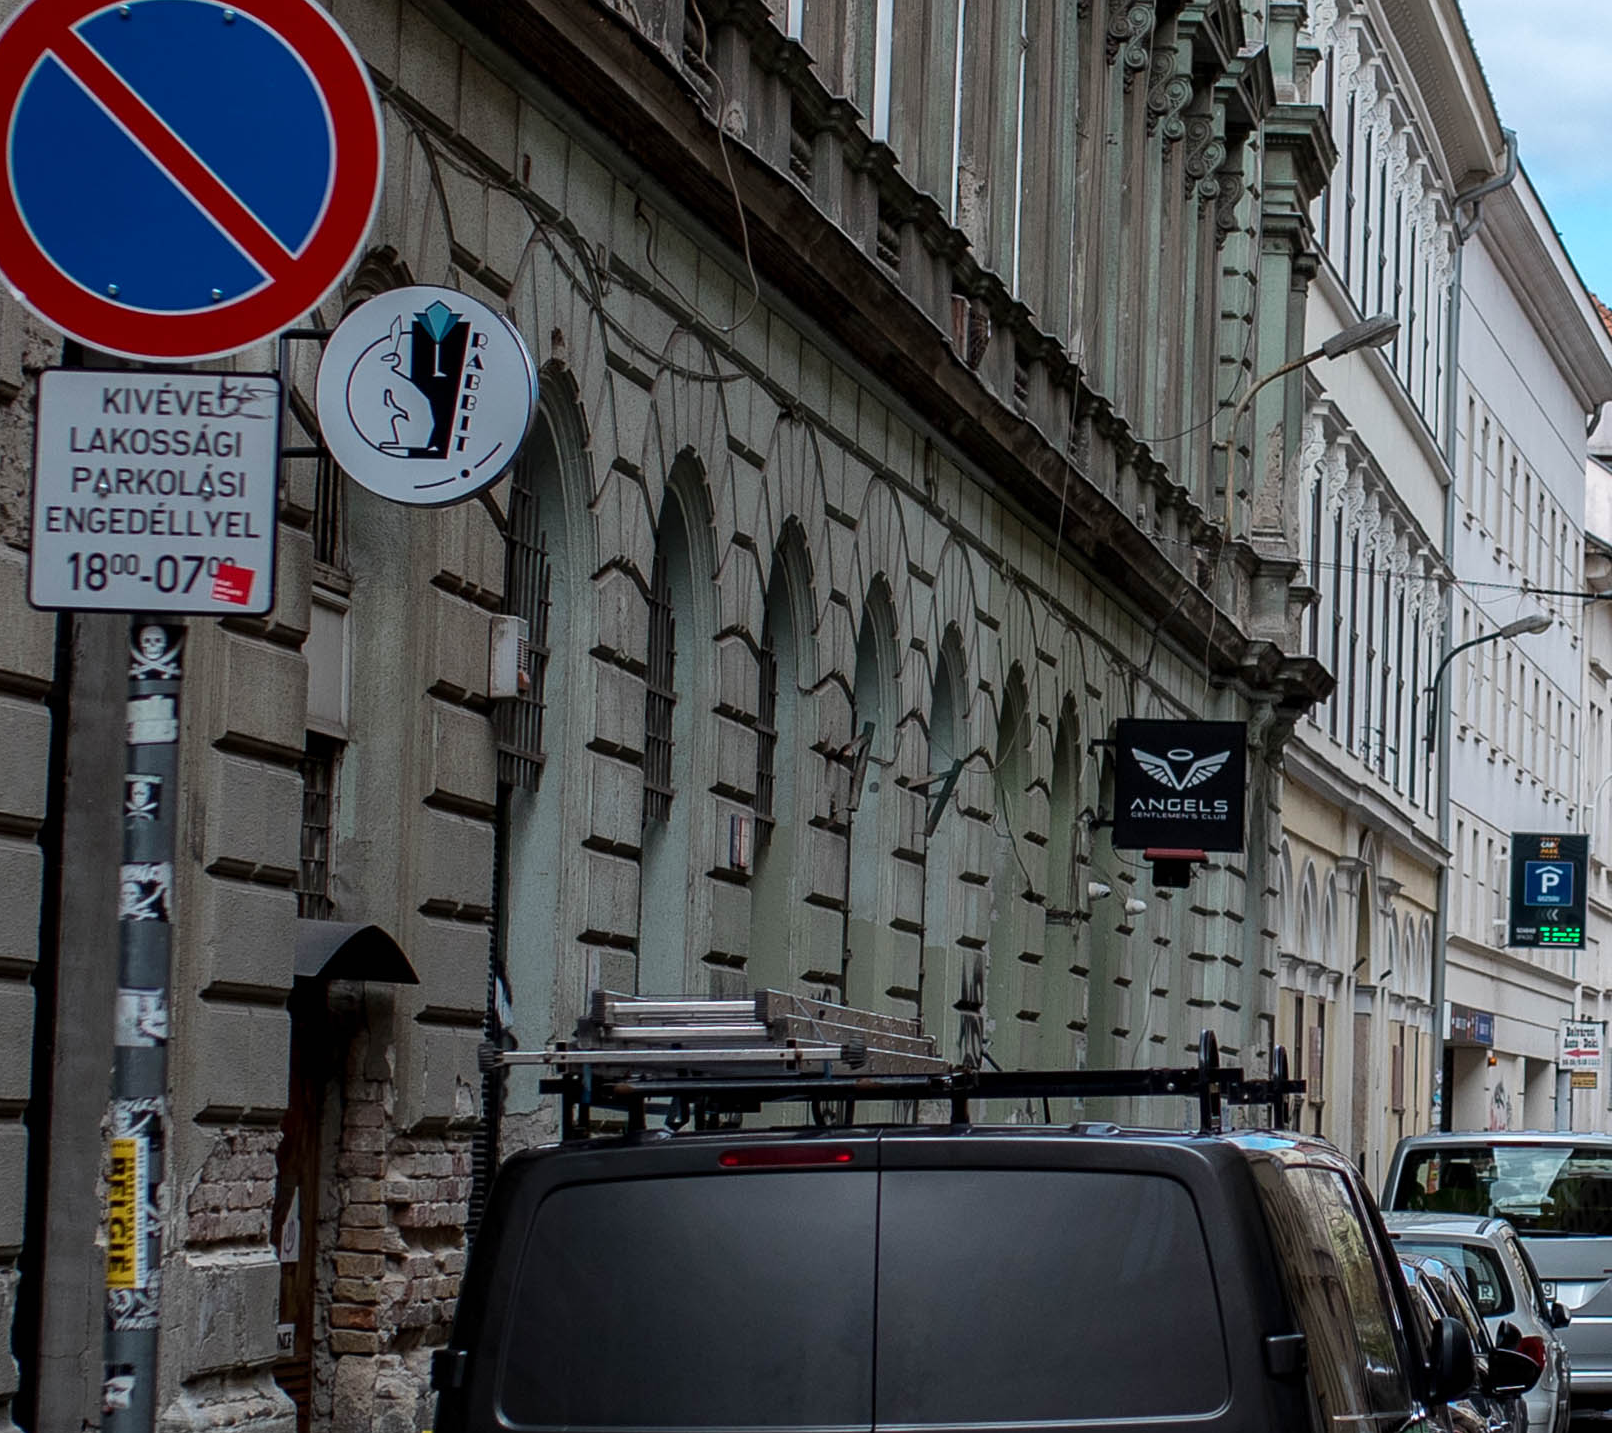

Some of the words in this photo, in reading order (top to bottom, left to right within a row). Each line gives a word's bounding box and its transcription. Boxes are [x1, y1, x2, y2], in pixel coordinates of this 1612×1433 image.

[455, 332, 488, 452] RABBIT
[69, 423, 242, 458] LAKOSSÁGI
[71, 464, 246, 499] PARKOLÁSI
[46, 502, 261, 539] ENGEDÉLLYEL
[1130, 798, 1228, 813] ANGELS
[1201, 813, 1227, 821] CLUB
[1541, 872, 1560, 894] P
